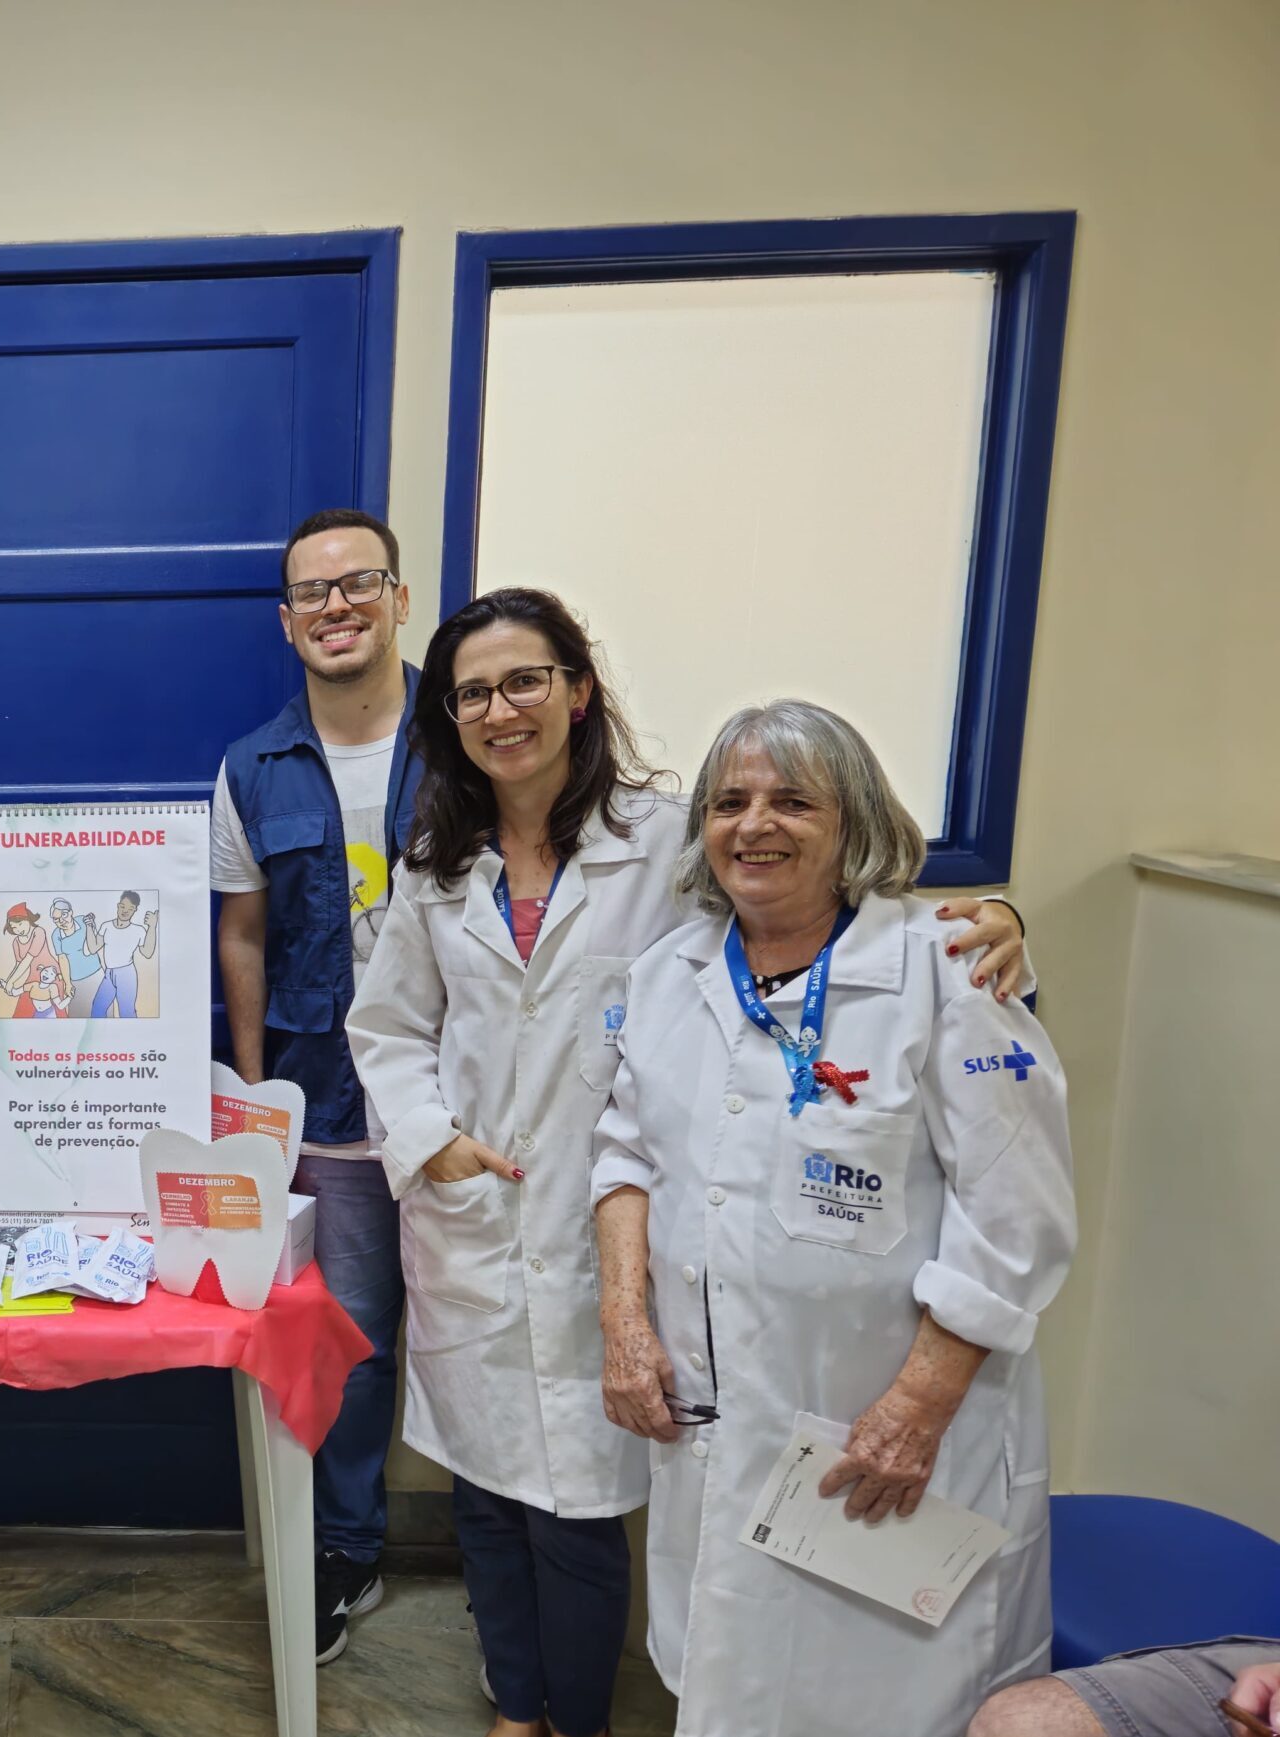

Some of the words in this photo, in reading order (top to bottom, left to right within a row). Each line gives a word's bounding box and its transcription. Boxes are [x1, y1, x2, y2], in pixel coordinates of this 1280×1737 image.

[496, 888, 506, 913] SAÚDE
[810, 961, 824, 991] SAÚDE
[808, 996, 817, 1008] Rio
[8, 1050, 49, 1062] Todas
[55, 1053, 71, 1062] as
[76, 1052, 136, 1064] pessoas
[140, 1050, 167, 1062] são
[964, 1055, 1000, 1075] SUS
[16, 1066, 101, 1080] vulneráveis
[105, 1069, 124, 1079] ao
[129, 1066, 159, 1079] HIV.
[8, 1101, 34, 1113] Por
[38, 1101, 66, 1113] isso
[71, 1100, 79, 1113] é
[84, 1102, 167, 1116] importante
[222, 1100, 272, 1117] DEZEMBRO
[13, 1118, 82, 1133] aprender
[86, 1120, 103, 1130] as
[108, 1118, 161, 1130] formas
[34, 1135, 53, 1147] de
[57, 1135, 140, 1150] prevenção.
[178, 1177, 236, 1187] DEZEMBRO
[834, 1163, 883, 1192] Rio
[801, 1183, 883, 1203] PREFEITURA
[817, 1204, 865, 1223] SAÚDE
[27, 1249, 52, 1262] RIO
[109, 1254, 136, 1274] RIO
[105, 1278, 119, 1287] Rio
